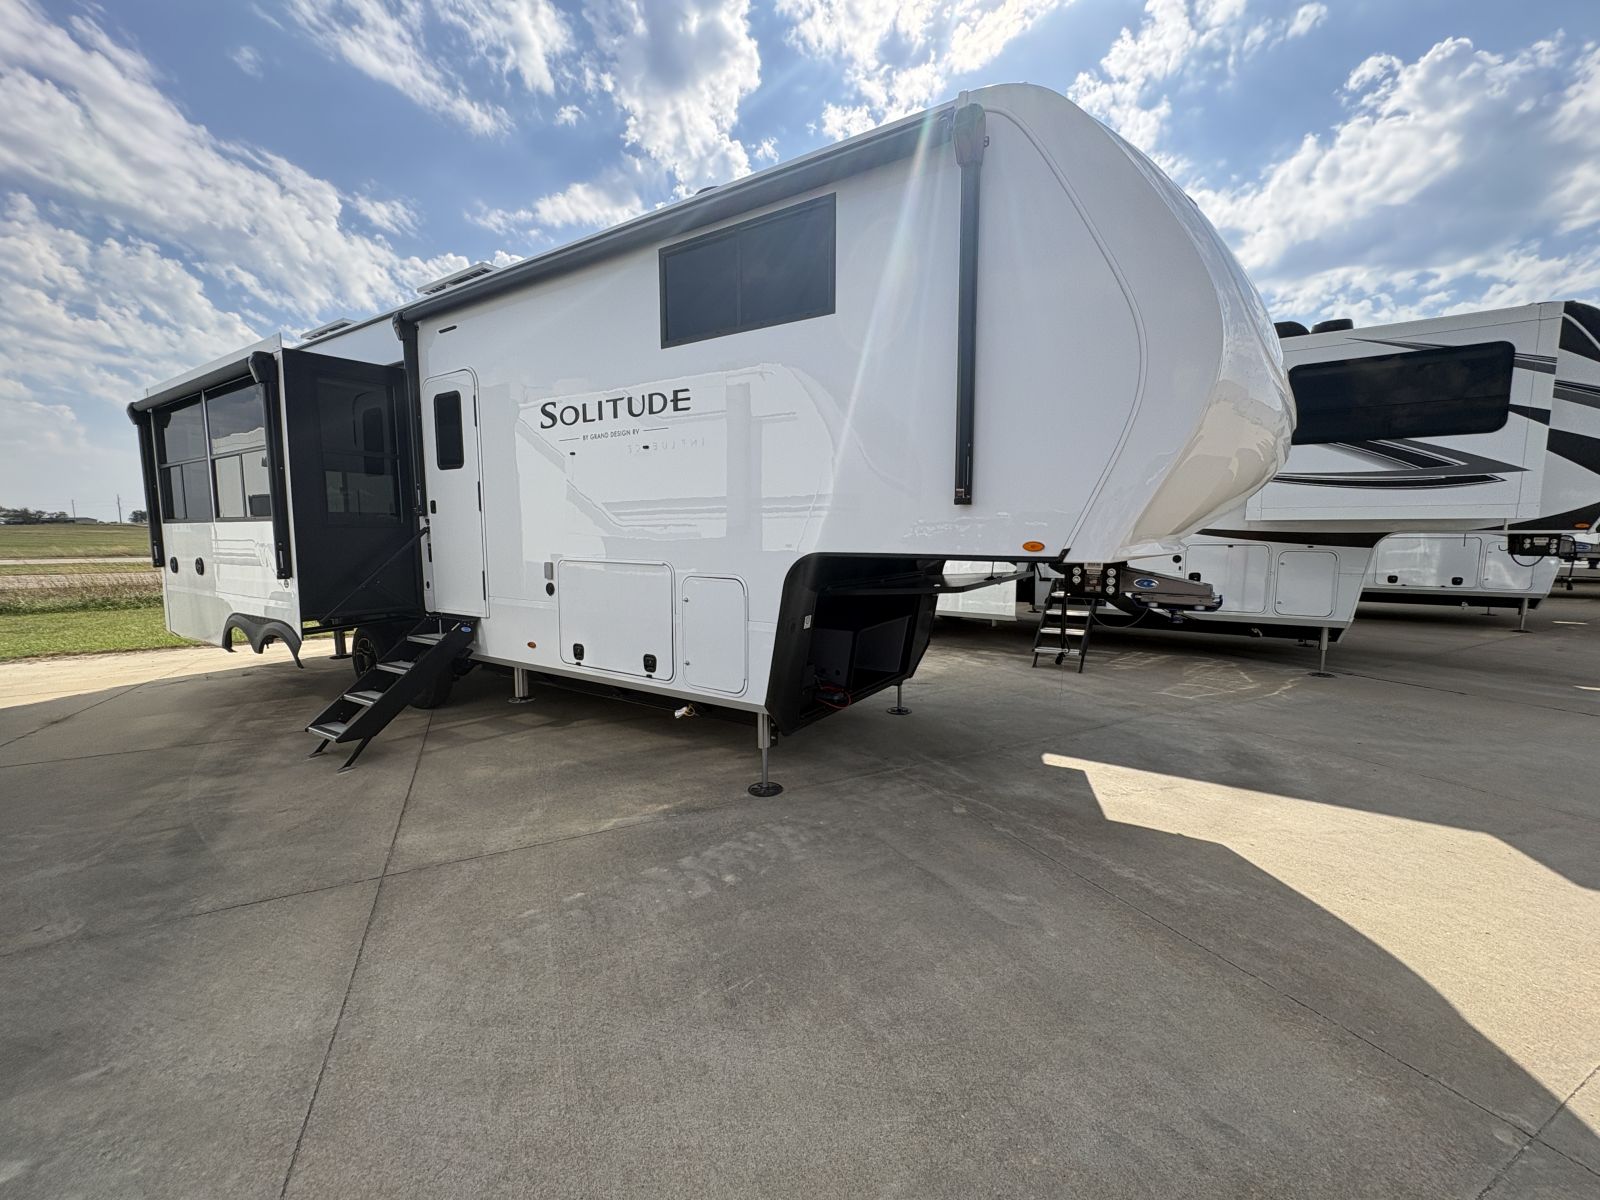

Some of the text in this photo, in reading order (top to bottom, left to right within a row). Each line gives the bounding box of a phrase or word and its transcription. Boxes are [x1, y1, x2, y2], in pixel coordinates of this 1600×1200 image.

[540, 388, 692, 430] SOLITUDE
[590, 431, 609, 440] GRAND
[610, 429, 631, 438] DESIGN
